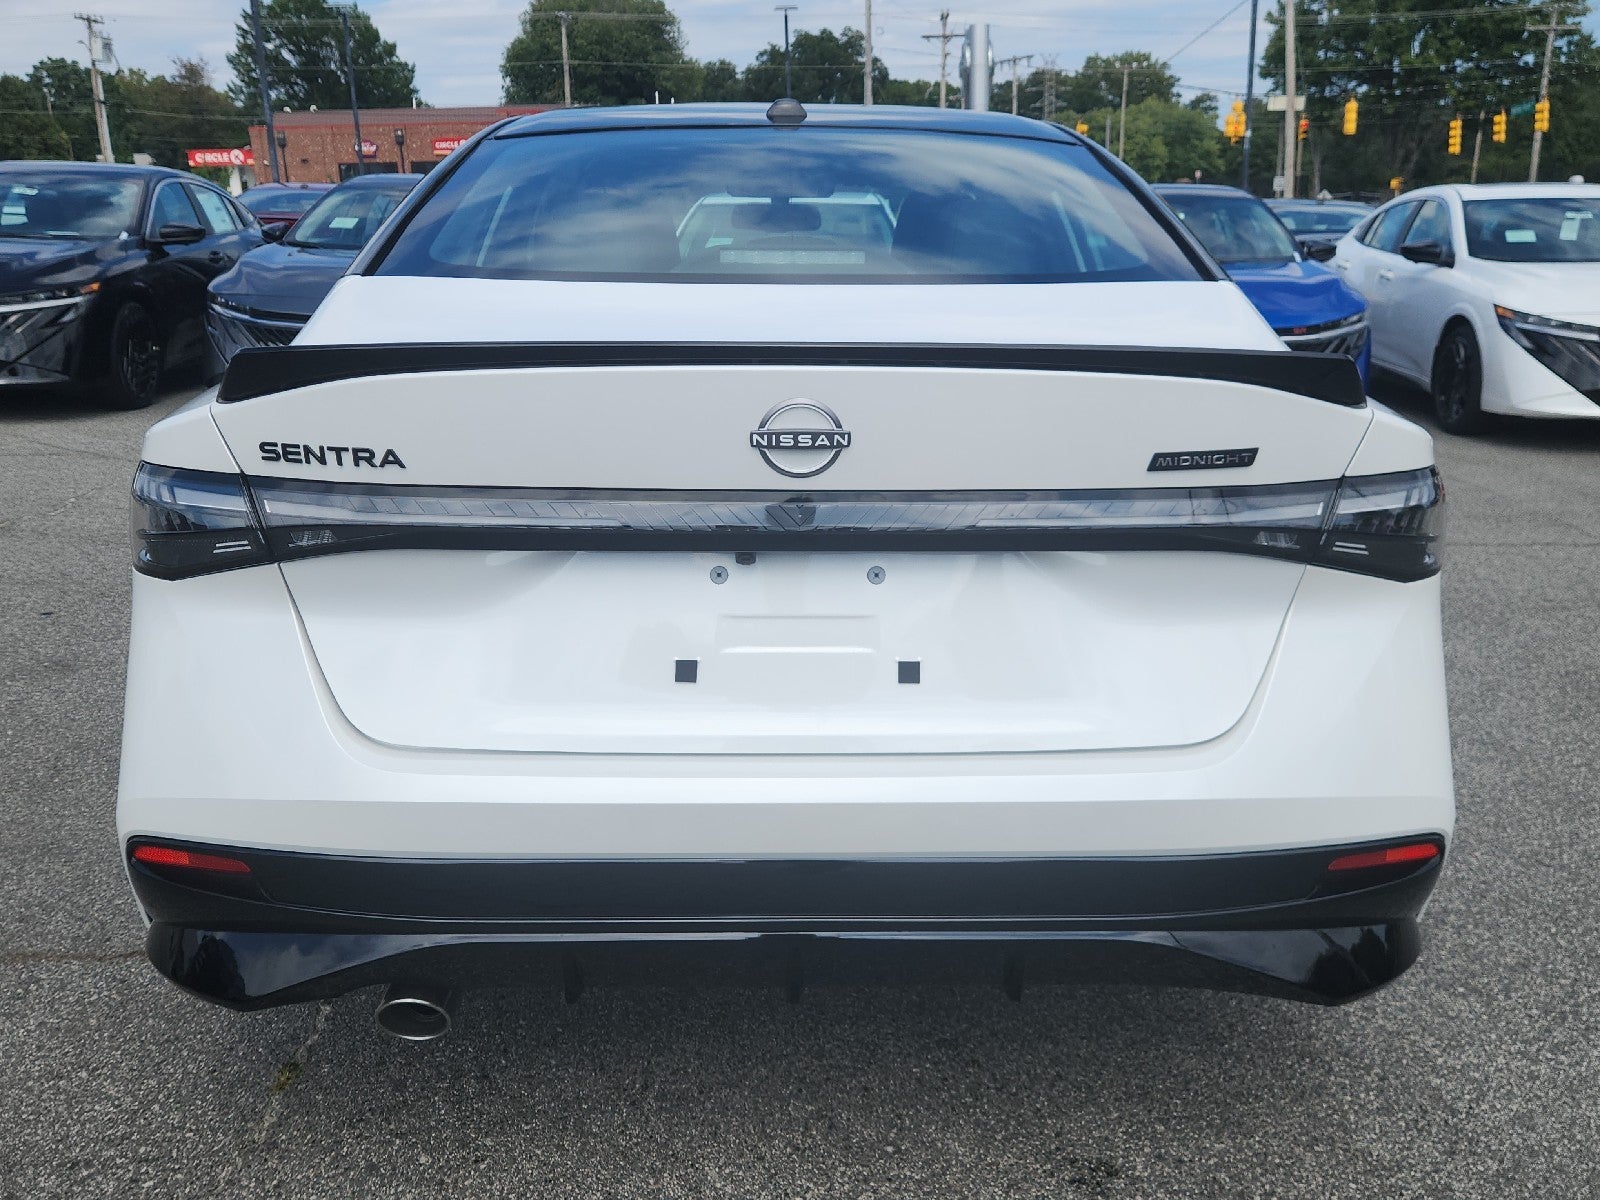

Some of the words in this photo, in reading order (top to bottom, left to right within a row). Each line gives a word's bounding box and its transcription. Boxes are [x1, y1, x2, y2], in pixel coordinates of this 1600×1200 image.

[194, 152, 230, 163] CIRCLE
[230, 149, 245, 165] K
[752, 433, 849, 447] NISSAN
[259, 441, 406, 468] SENTRA
[1155, 452, 1254, 467] MIDNIGHT
